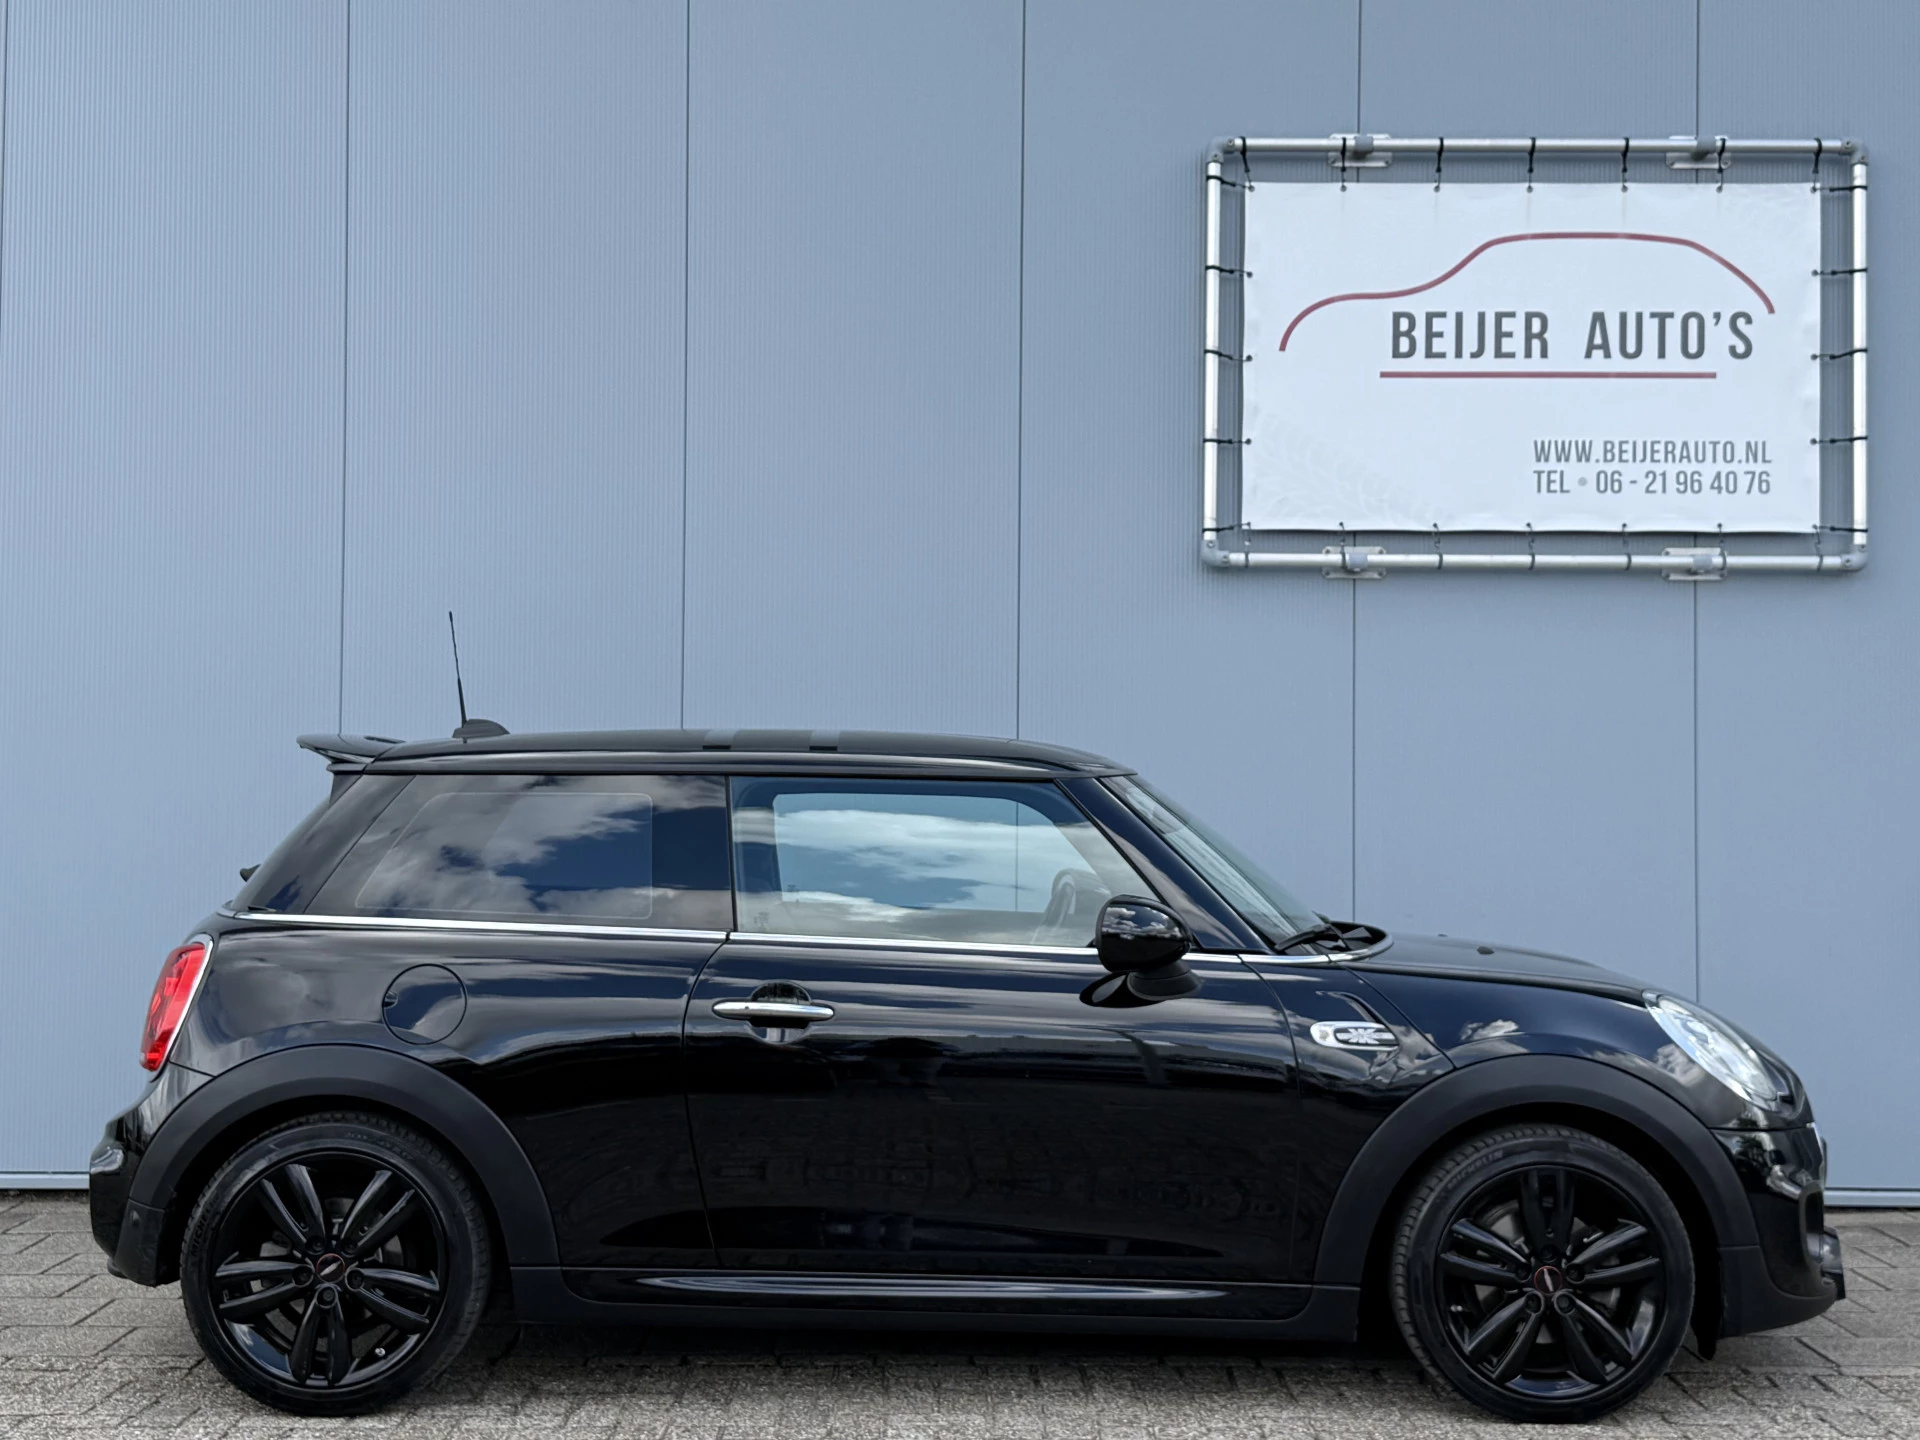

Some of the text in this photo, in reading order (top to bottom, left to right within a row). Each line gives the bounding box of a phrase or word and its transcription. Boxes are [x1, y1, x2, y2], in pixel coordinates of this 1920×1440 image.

[1391, 311, 1753, 360] BEIJER AUTO'S
[1533, 440, 1772, 463] WWW.BEIJERAUTO.NL
[1533, 470, 1570, 493] TEL
[1596, 470, 1623, 493] 06
